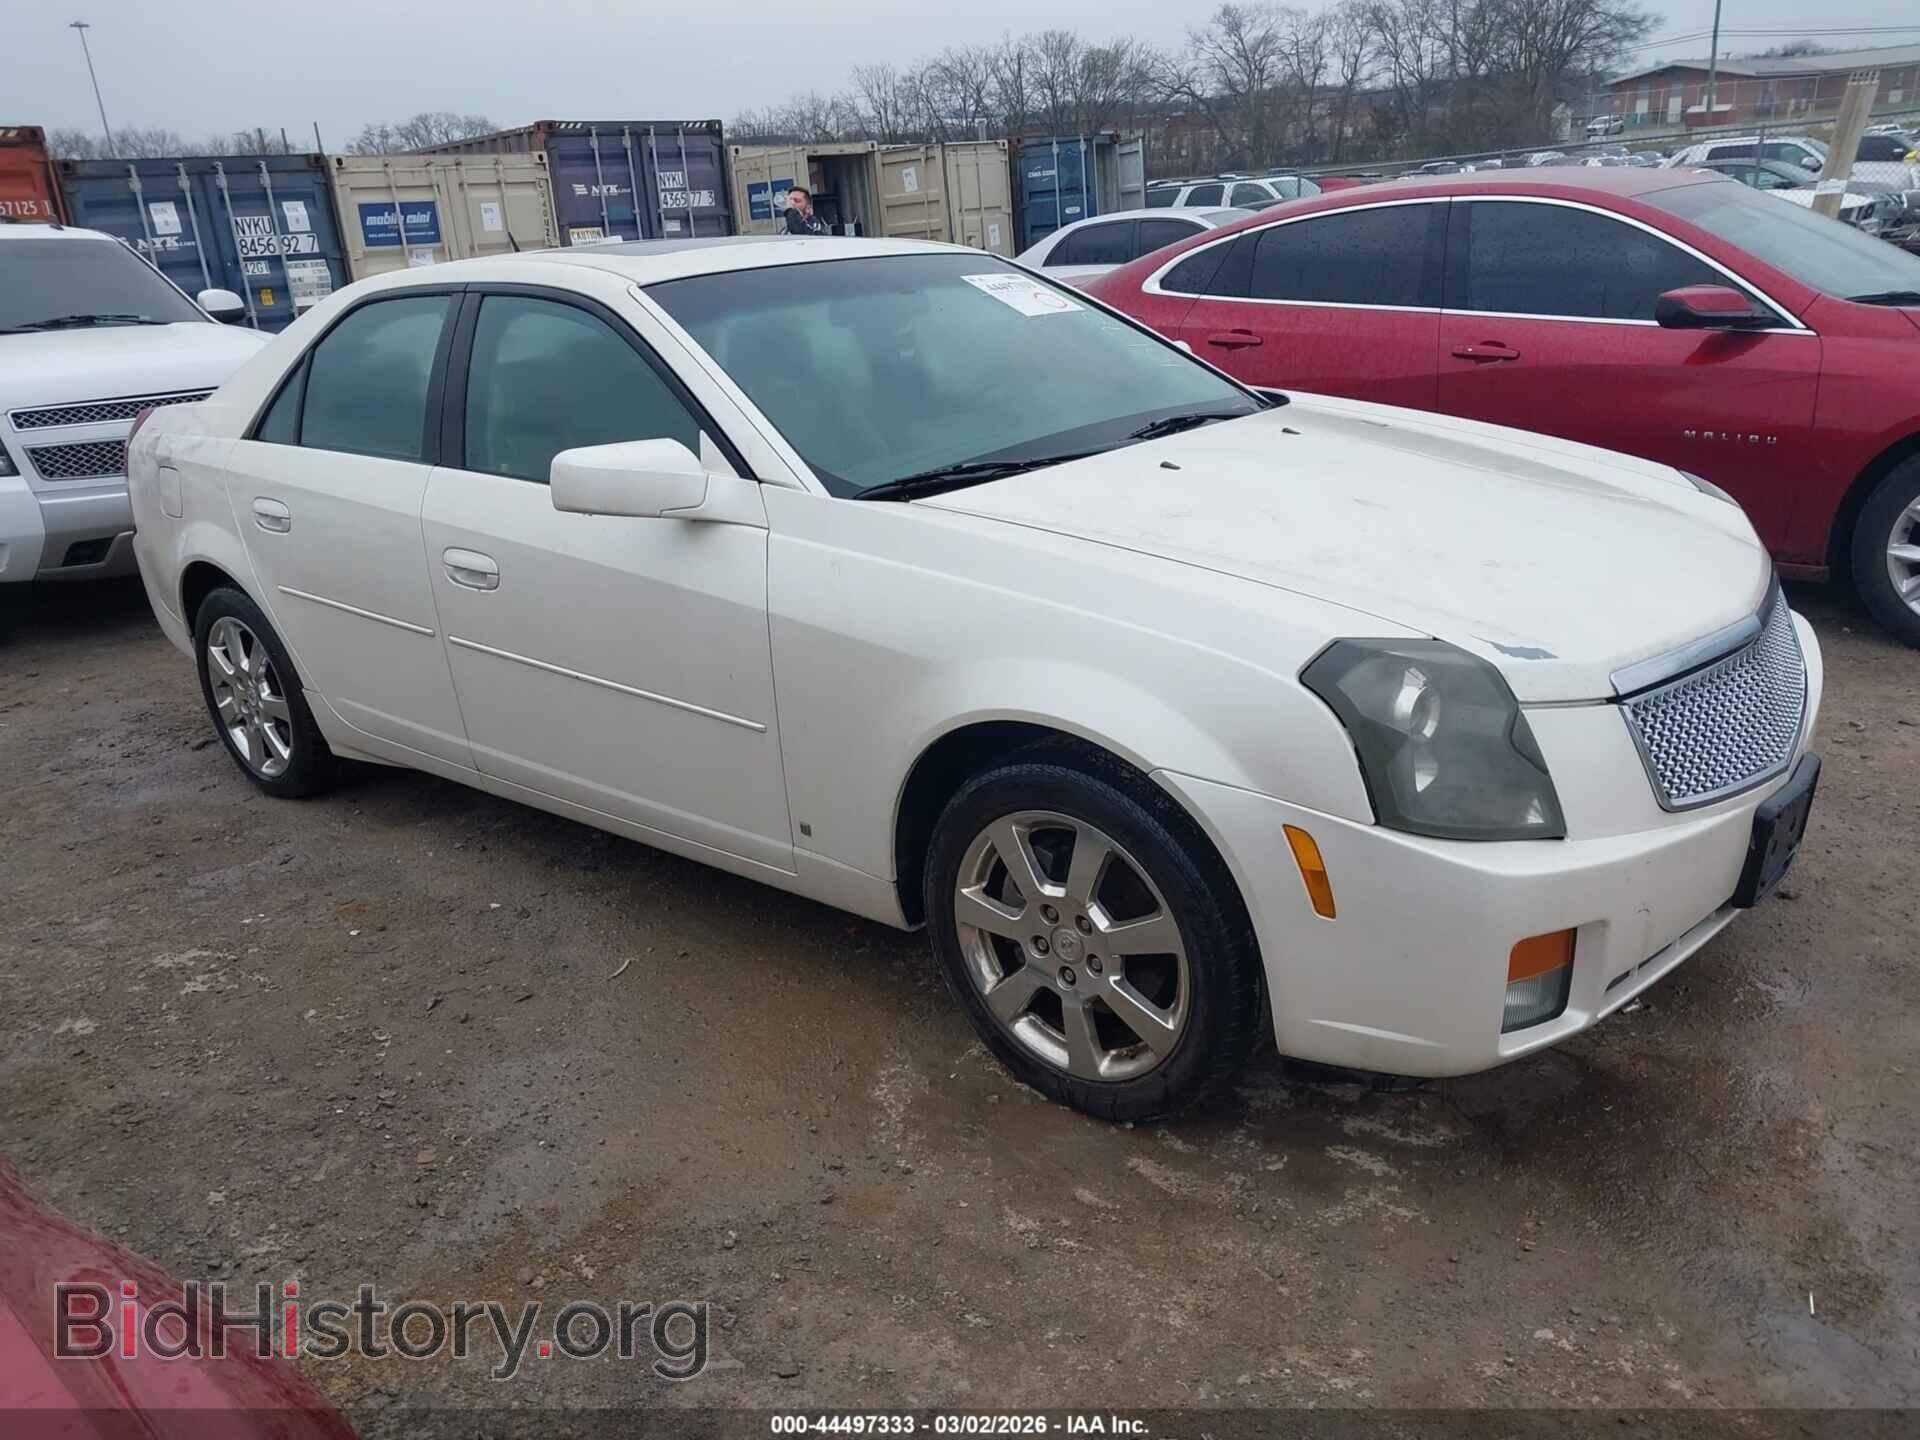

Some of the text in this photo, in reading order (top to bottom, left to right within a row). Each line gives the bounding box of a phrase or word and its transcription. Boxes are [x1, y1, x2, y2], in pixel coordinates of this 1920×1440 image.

[660, 172, 684, 188] NYKU
[662, 190, 714, 207] 436577 3
[406, 211, 431, 223] mini
[235, 217, 273, 236] NYKU
[240, 234, 317, 255] 845692 7
[1683, 430, 1777, 444] MALIBU
